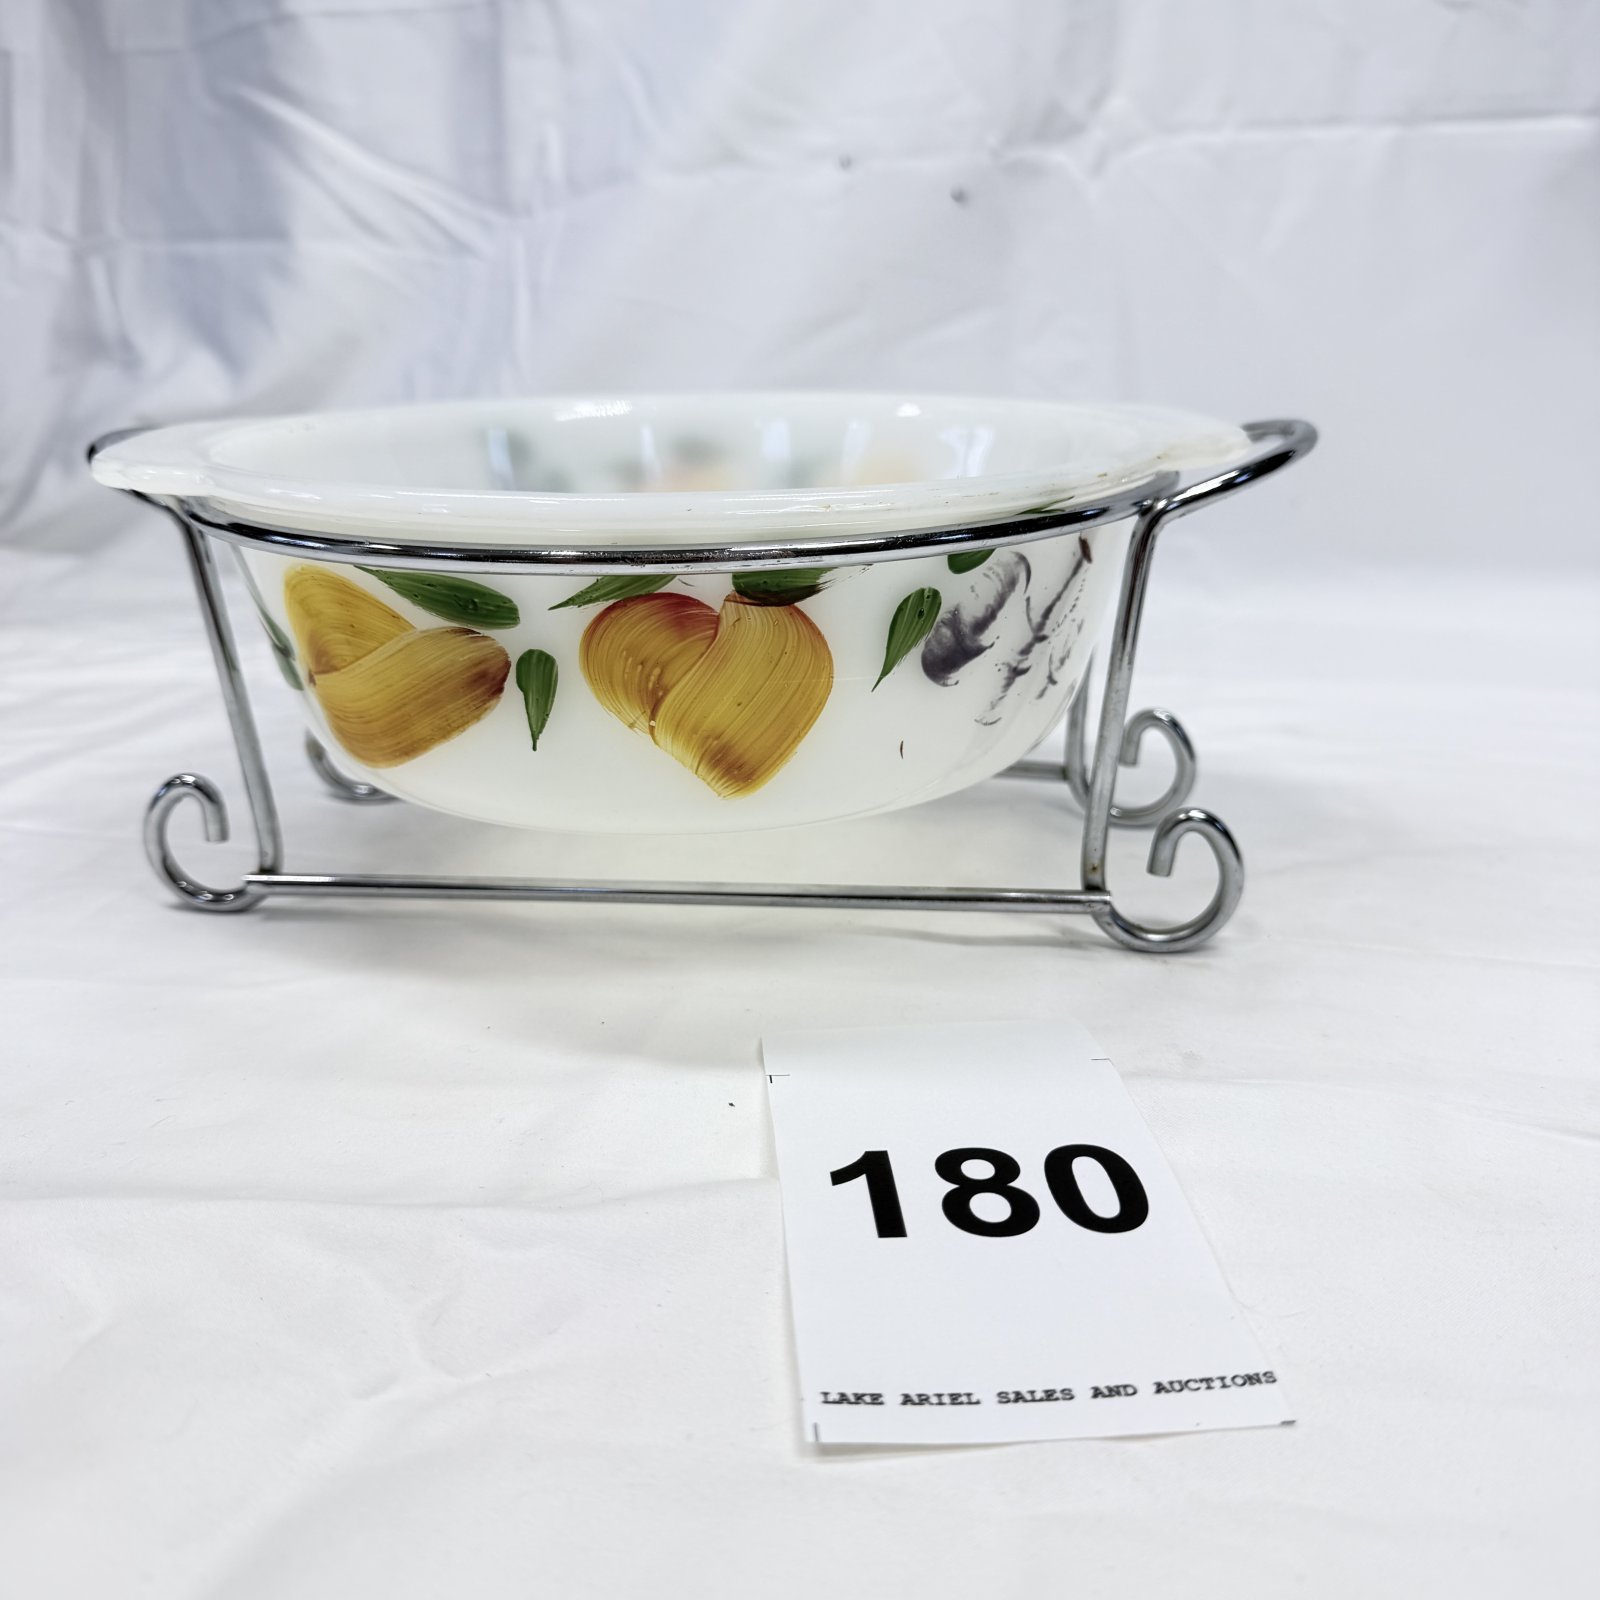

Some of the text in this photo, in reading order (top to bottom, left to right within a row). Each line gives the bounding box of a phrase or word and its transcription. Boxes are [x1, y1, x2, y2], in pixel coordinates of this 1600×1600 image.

[829, 1143, 1149, 1239] 180
[820, 1370, 1278, 1406] LAKE ARIEL SALES AND AUCTIONS
